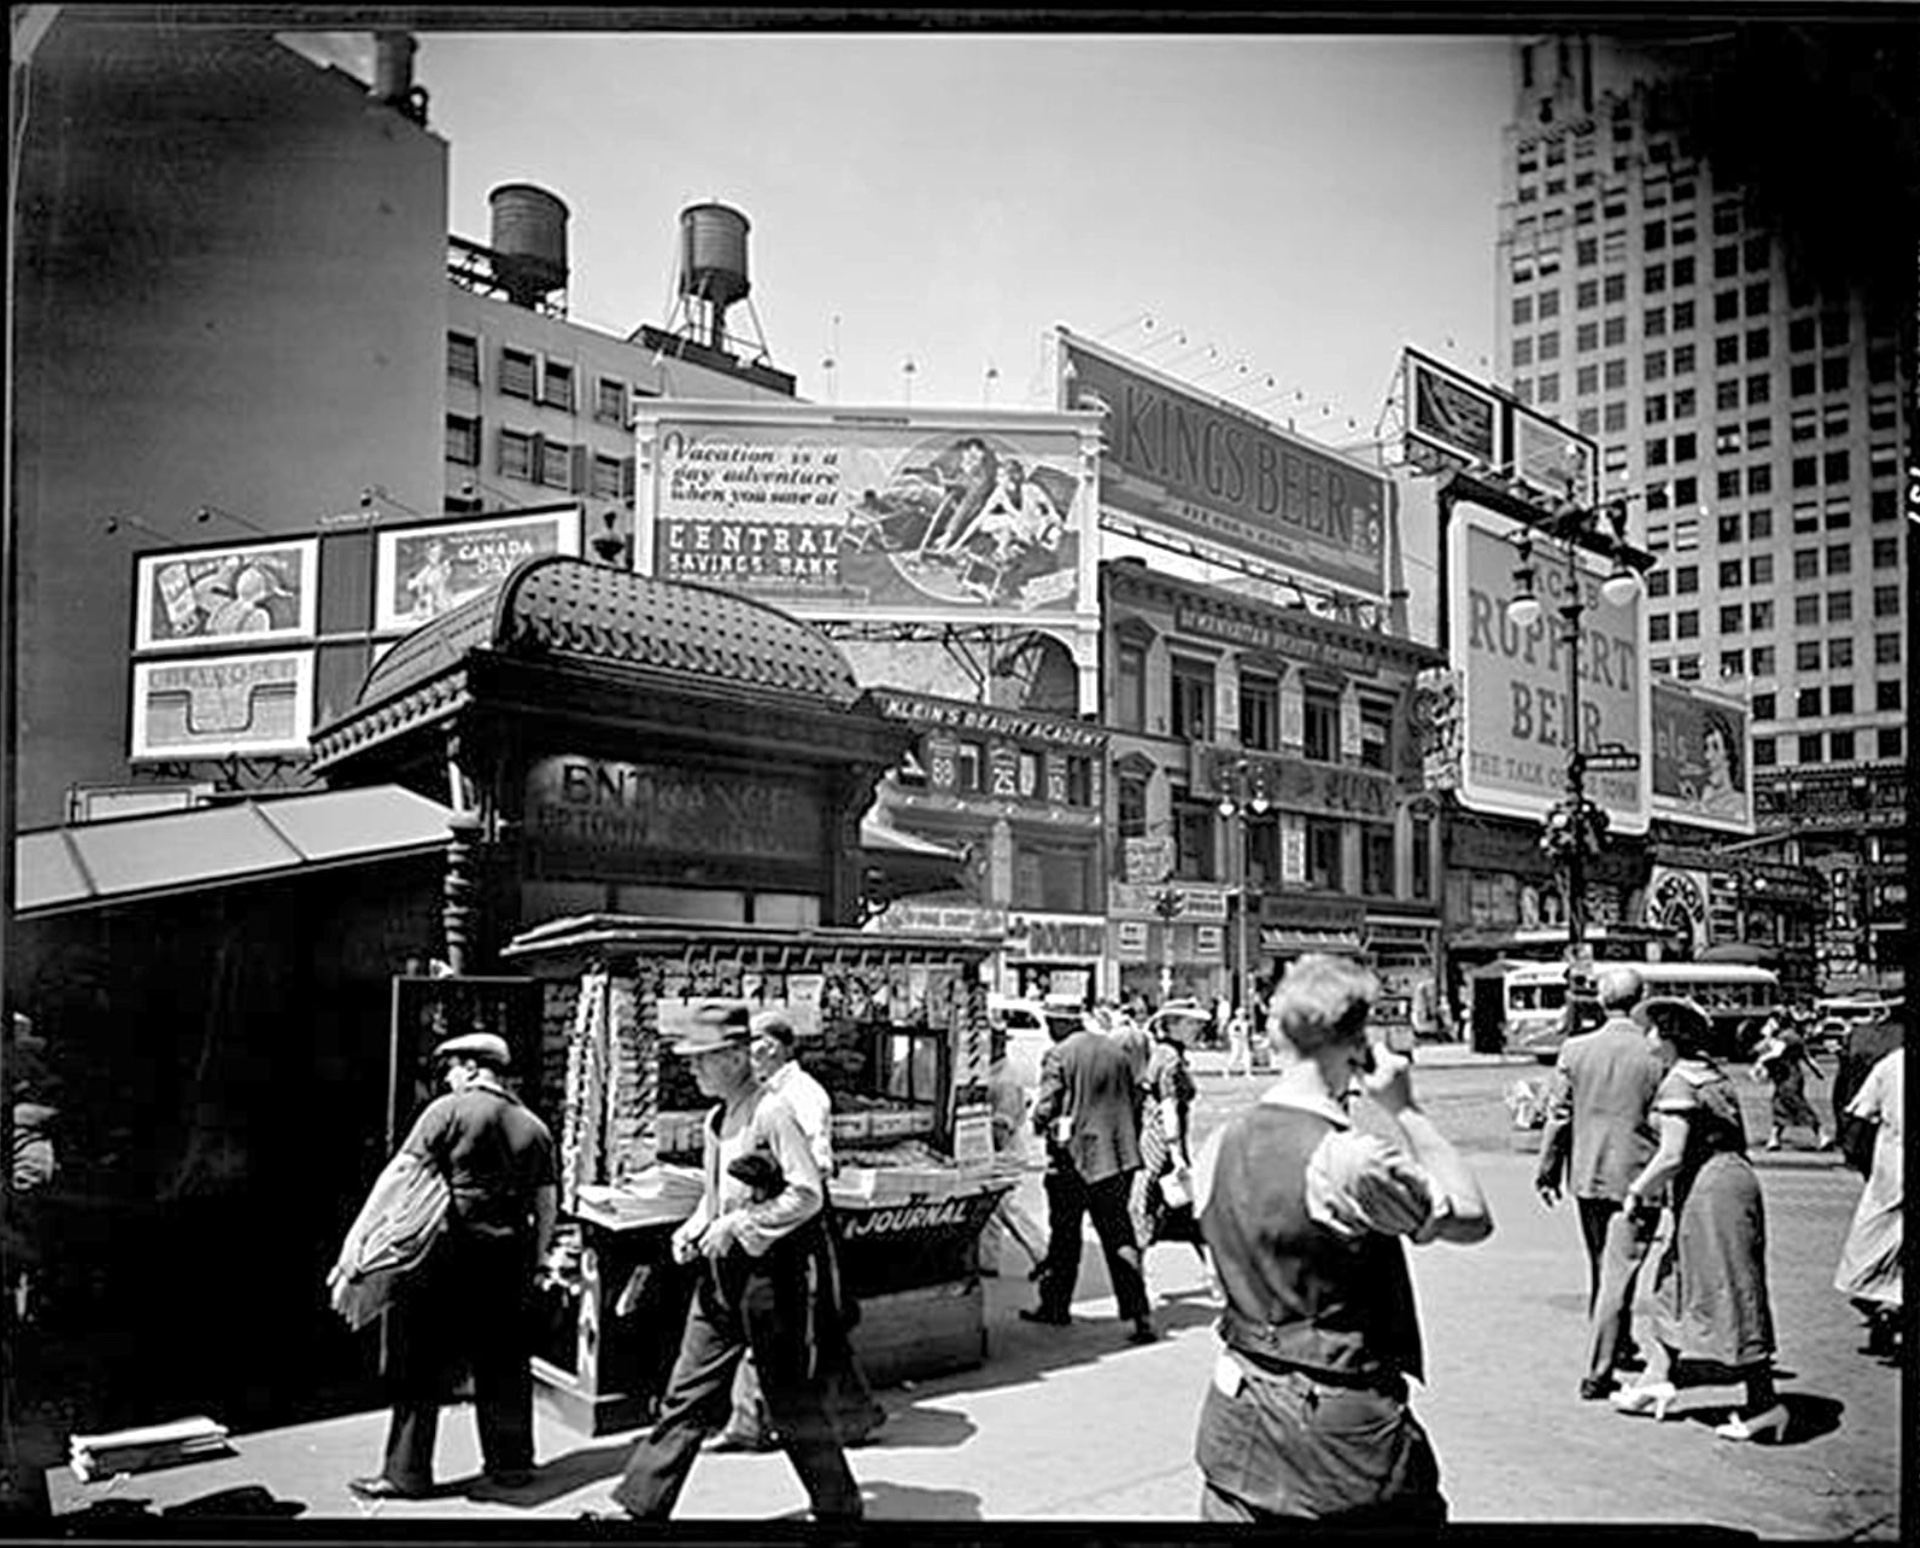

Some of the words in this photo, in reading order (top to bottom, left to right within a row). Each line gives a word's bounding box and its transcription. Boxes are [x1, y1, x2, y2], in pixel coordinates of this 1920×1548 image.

[664, 431, 774, 462] Vacation
[792, 451, 811, 464] is
[822, 452, 839, 466] a
[672, 465, 713, 487] gay
[722, 465, 840, 485] adventure
[1120, 385, 1246, 503] KINGS
[1254, 441, 1349, 543] BEER
[671, 485, 725, 501] when
[727, 489, 767, 508] you
[814, 491, 839, 506] at
[458, 539, 535, 560] CANADA
[669, 525, 839, 555] CENTRAL
[669, 552, 764, 573] SAVINGS
[777, 556, 839, 576] BANK
[964, 711, 1031, 737] BEAUTY
[1031, 723, 1107, 749] ACADEMY
[855, 1200, 968, 1236] JOURNAL
